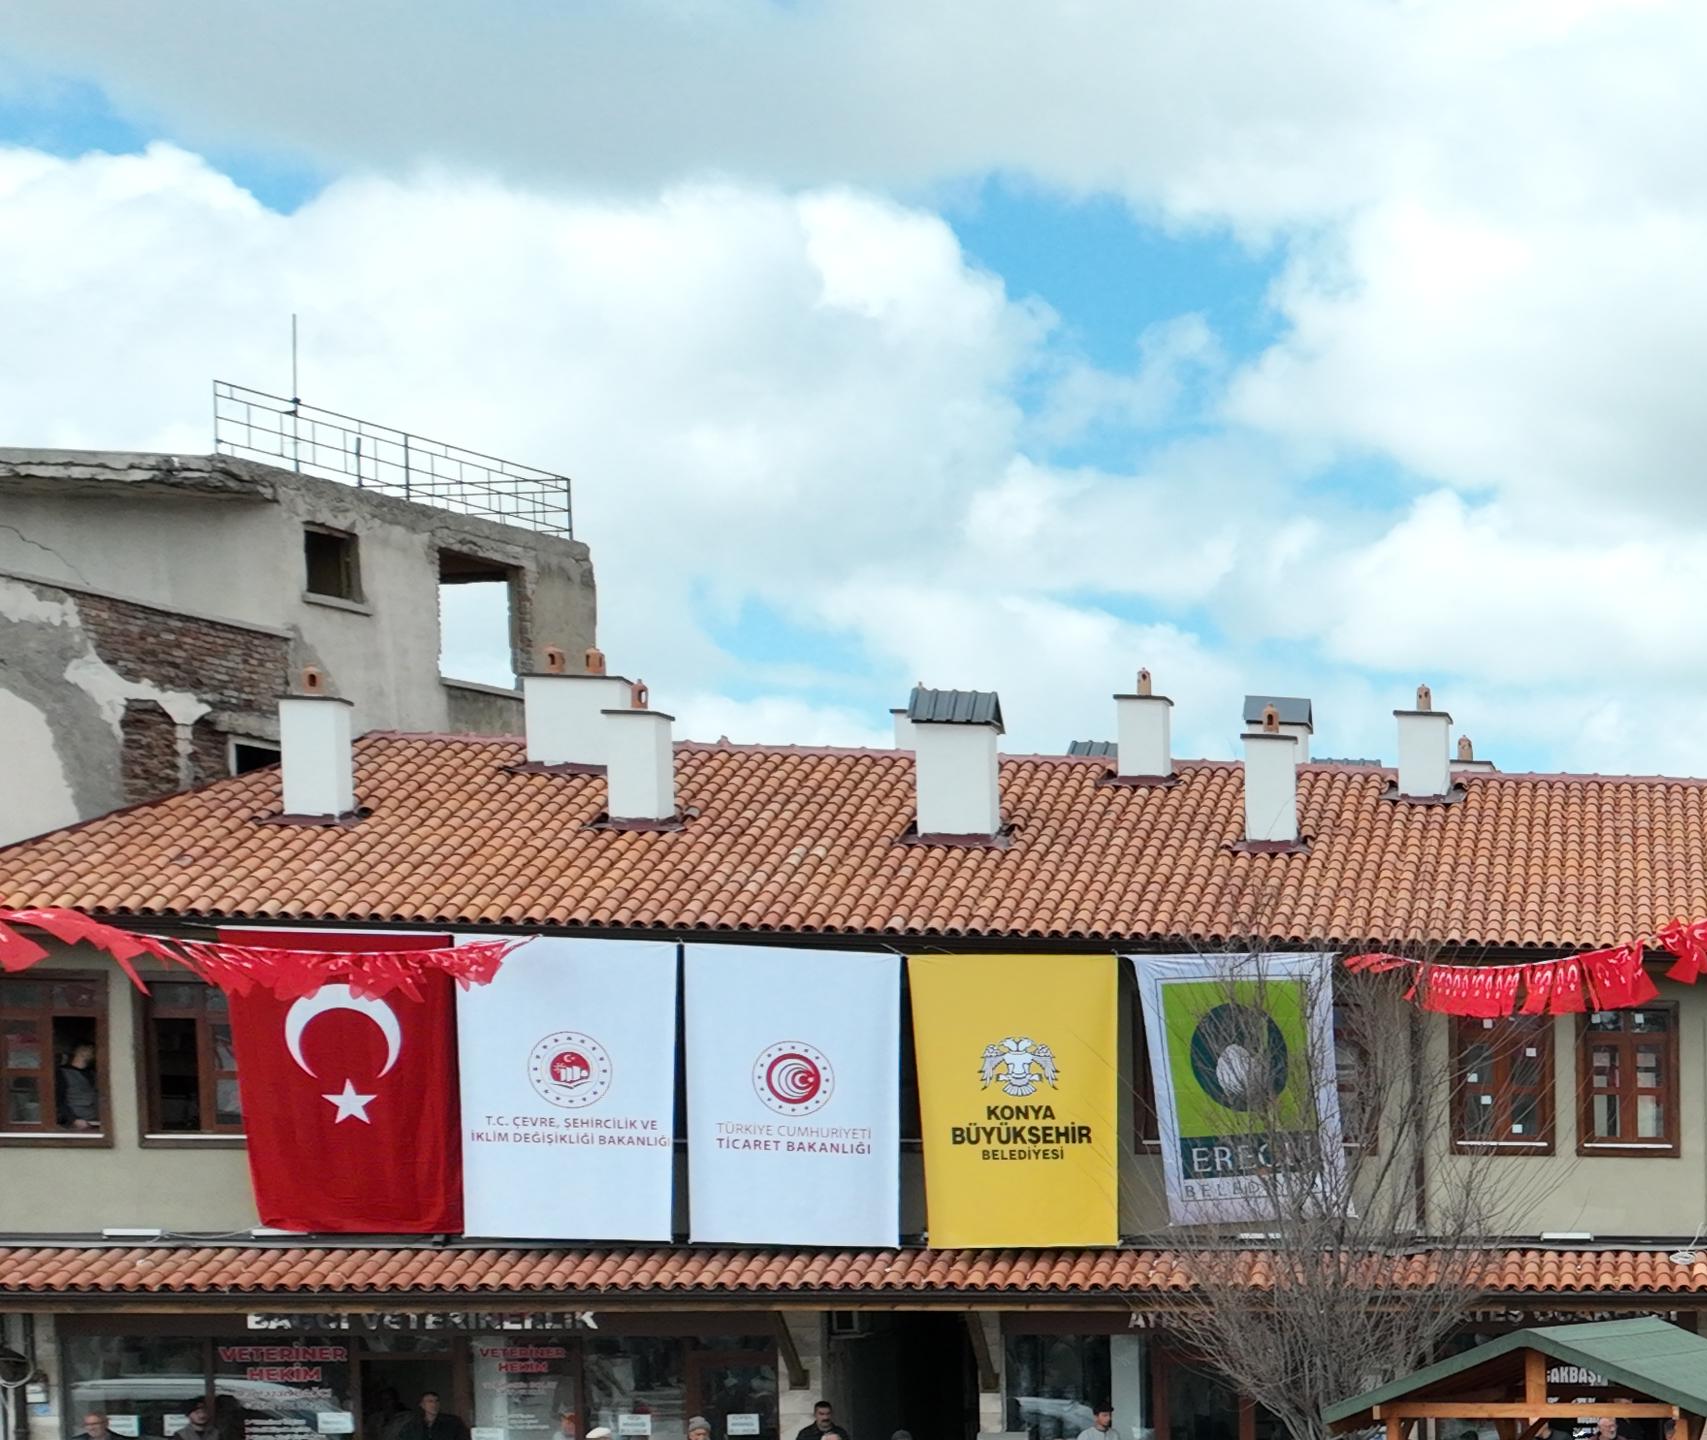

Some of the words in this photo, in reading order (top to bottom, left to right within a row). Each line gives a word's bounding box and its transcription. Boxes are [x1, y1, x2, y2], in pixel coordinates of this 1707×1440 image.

[986, 1104, 1056, 1121] KONYA
[485, 1116, 510, 1127] T.C.
[512, 1116, 560, 1129] ÇEVRE,
[563, 1116, 637, 1130] ŞEHİRCİLİK
[641, 1119, 659, 1131] VE
[715, 1121, 775, 1136] TÜRKİYE
[776, 1123, 872, 1140] CUMHURİYETİ
[471, 1130, 509, 1142] İKLİM
[513, 1131, 595, 1146] DEĞİŞİKLİĞİ
[951, 1122, 1093, 1149] BÜYÜKŞEHİR
[716, 1136, 781, 1152] TİCARET
[785, 1139, 872, 1155] BAKANLIĞI
[981, 1147, 1065, 1161] BELEDİYESİ
[219, 1341, 348, 1363] VETERİNER
[479, 1344, 567, 1360] VETERİNER
[246, 1365, 322, 1383] HEKİM
